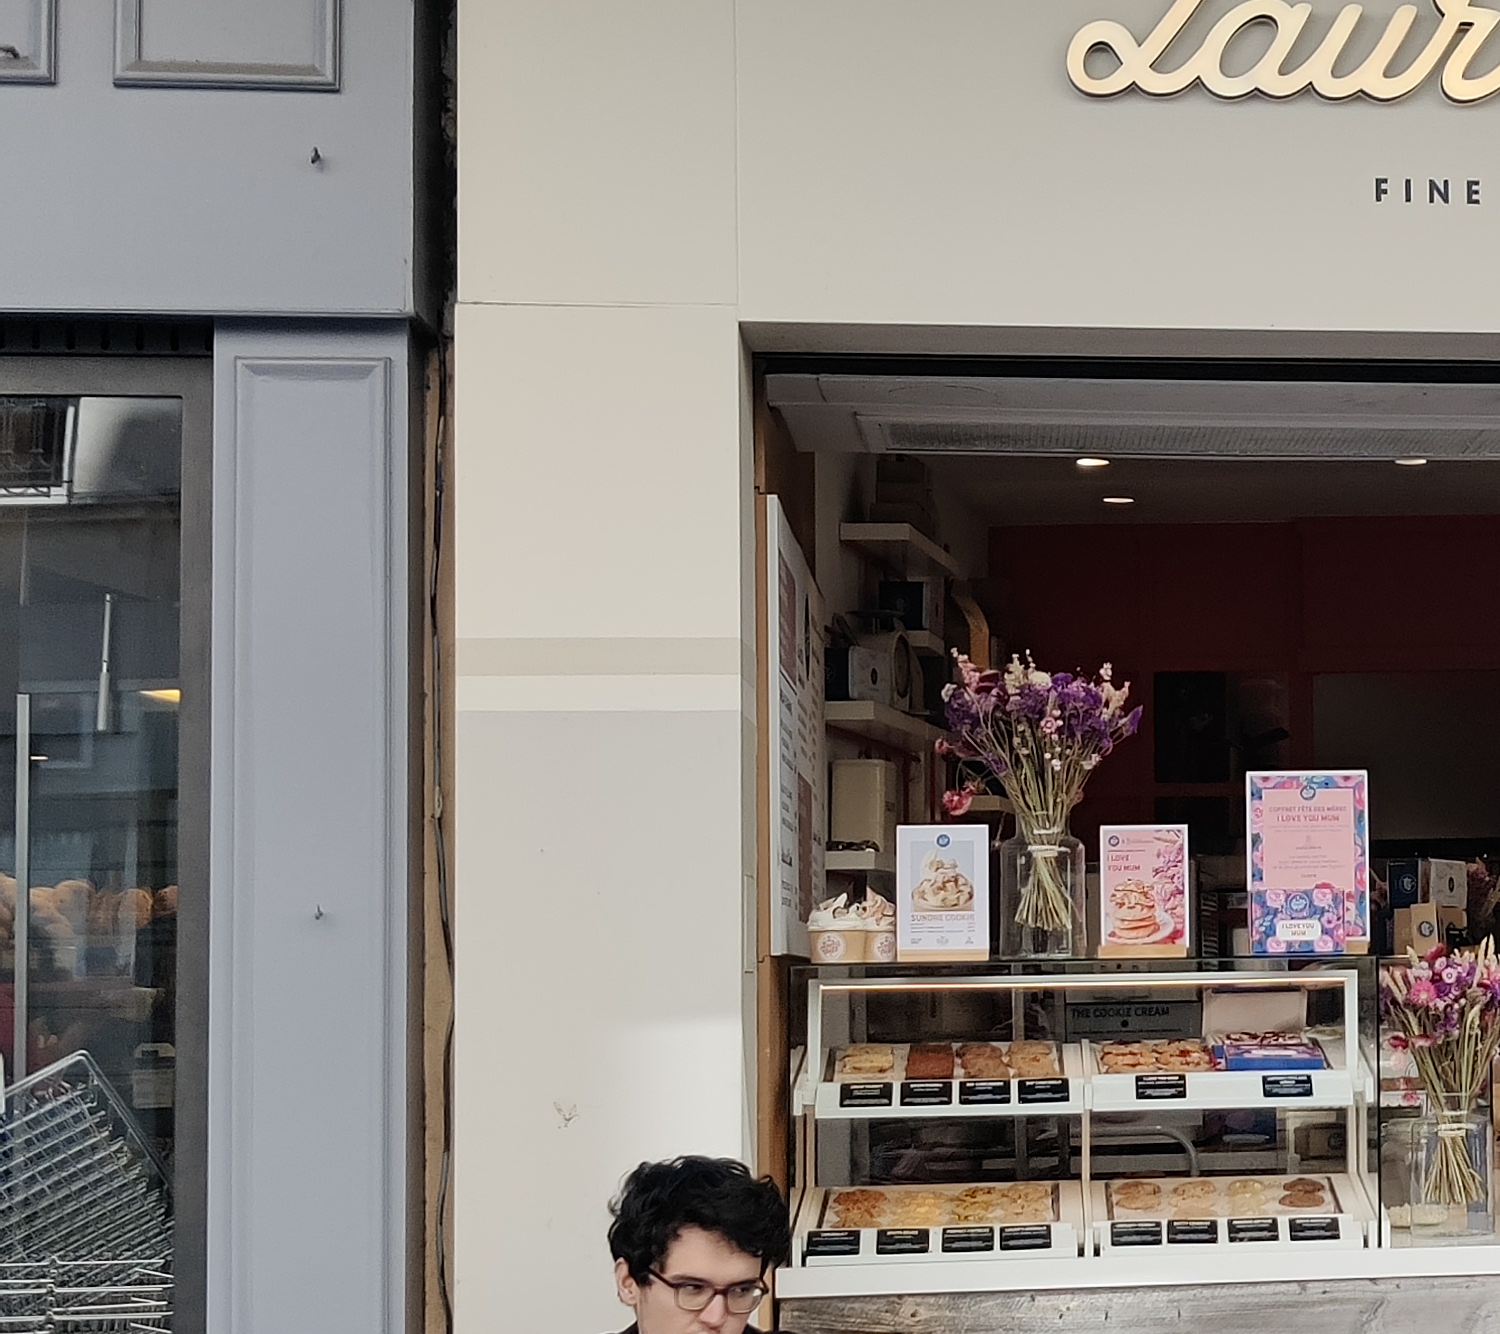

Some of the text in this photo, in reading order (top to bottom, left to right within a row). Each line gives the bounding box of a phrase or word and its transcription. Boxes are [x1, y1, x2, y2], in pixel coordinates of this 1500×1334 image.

[1374, 177, 1481, 205] FINE
[1281, 814, 1301, 823] LOVE
[1303, 814, 1319, 822] YOU
[1071, 1008, 1091, 1019] THE
[1134, 1006, 1170, 1017] CREAM
